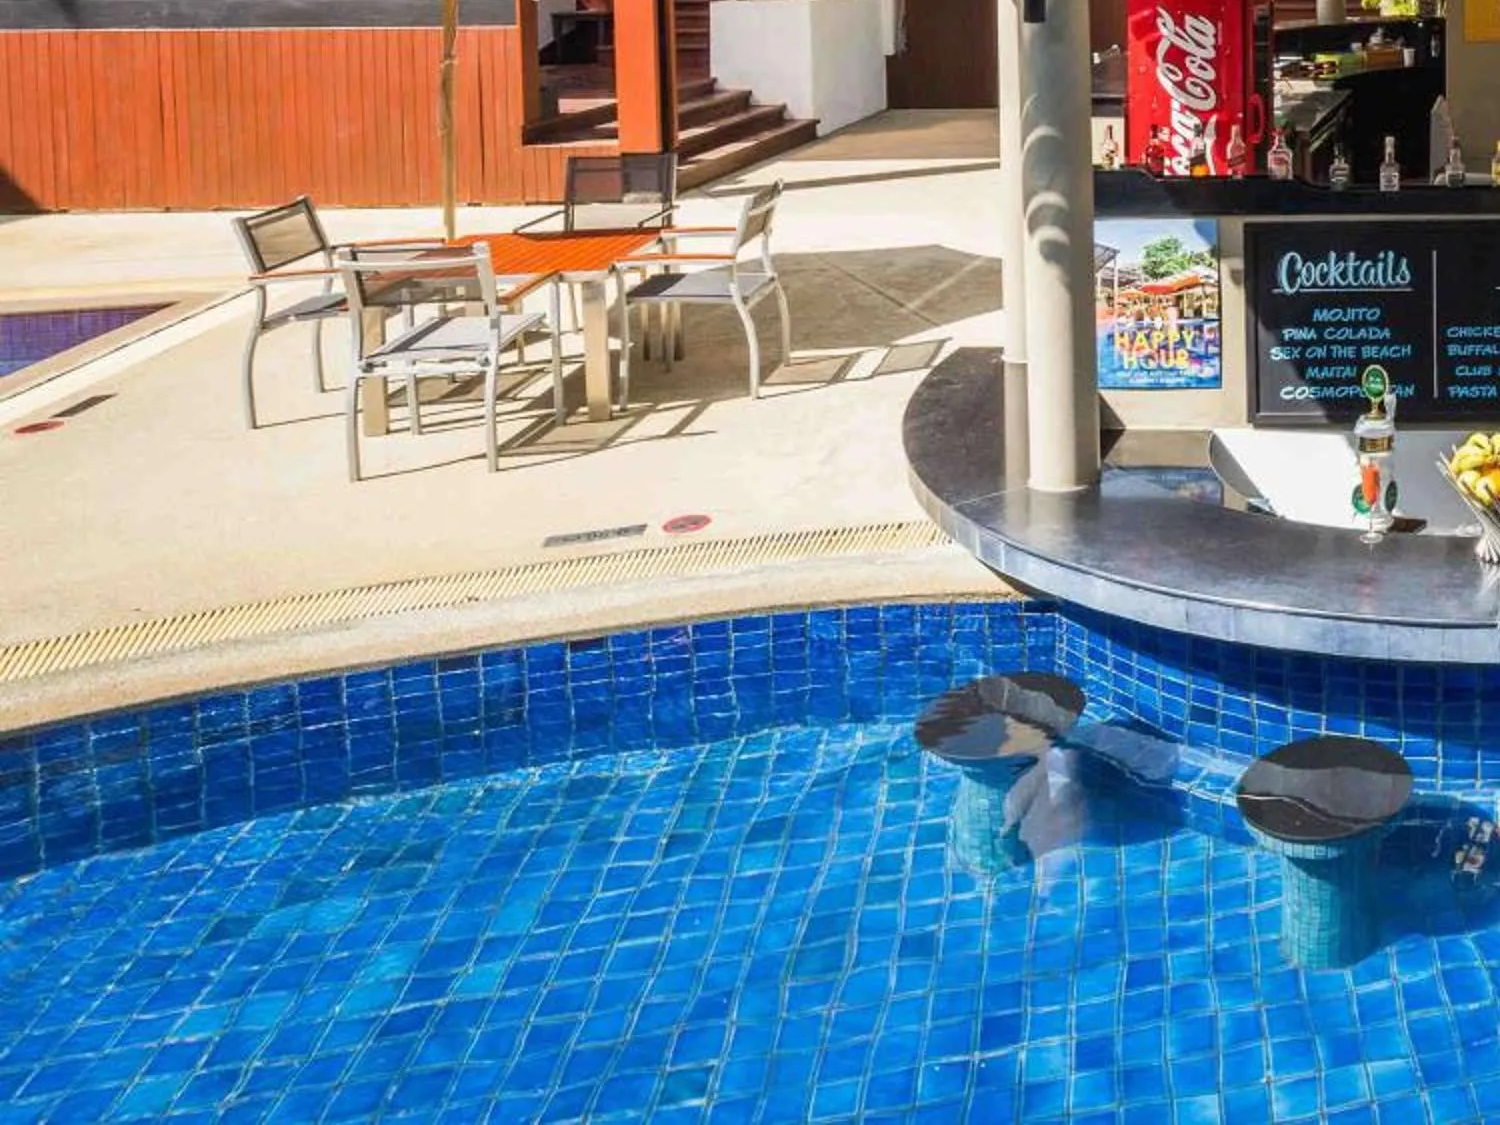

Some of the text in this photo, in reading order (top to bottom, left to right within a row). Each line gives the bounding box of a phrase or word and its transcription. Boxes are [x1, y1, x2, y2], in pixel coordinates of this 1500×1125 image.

[1155, 6, 1217, 176] oca-Cola
[1277, 250, 1412, 295] Cocktails
[1312, 306, 1382, 322] MOJITO
[1114, 329, 1195, 350] HAPPY
[1323, 326, 1391, 340] COLADA
[1123, 349, 1190, 370] HOUR
[1269, 344, 1412, 360] SEX ON THE BEACH
[1455, 364, 1492, 377] CLUB
